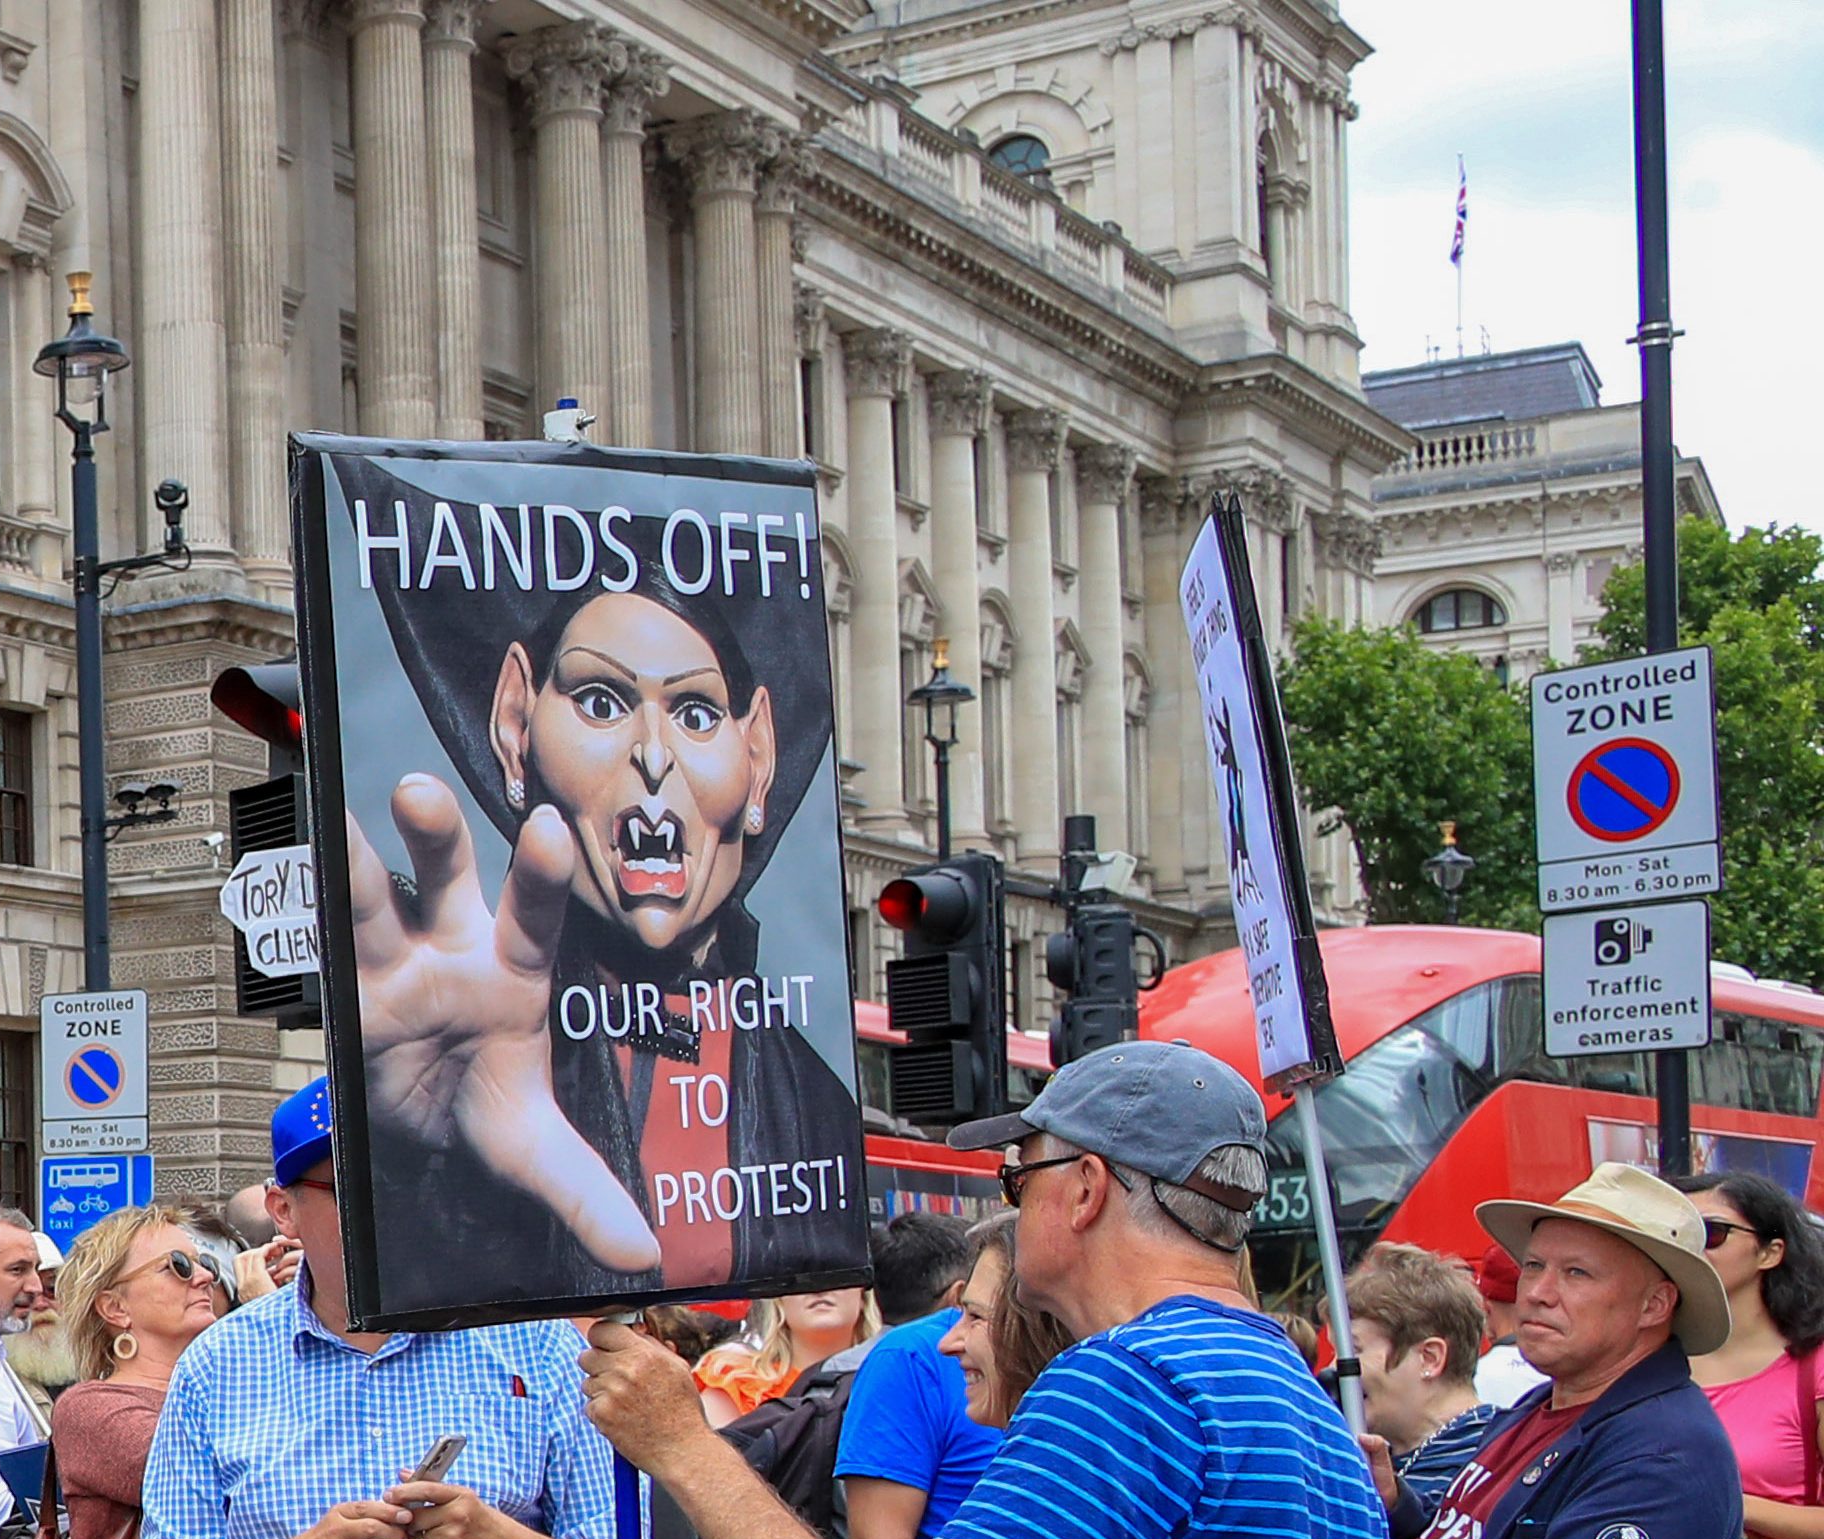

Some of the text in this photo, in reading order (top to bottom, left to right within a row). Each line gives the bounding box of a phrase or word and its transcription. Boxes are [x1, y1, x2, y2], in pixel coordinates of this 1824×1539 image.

[354, 499, 811, 600] HANDS OFF!
[1543, 659, 1697, 704] Controlled
[1566, 694, 1673, 736] ZONE
[1584, 864, 1623, 879] Mon
[1638, 857, 1671, 872] Sat
[232, 859, 290, 921] TORY
[1546, 884, 1590, 904] 8.30
[1593, 885, 1620, 898] am
[1634, 875, 1679, 893] 6.30
[1683, 873, 1712, 889] pm
[256, 923, 320, 966] CLIEN
[1586, 975, 1663, 998] Traffic
[54, 997, 135, 1015] Controlled
[559, 975, 814, 1041] OUR RIGHT
[1553, 996, 1699, 1025] enforcement
[65, 1019, 123, 1039] ZONE
[1578, 1026, 1674, 1047] cameras
[669, 1074, 730, 1129] TO
[70, 1124, 93, 1135] Mon
[101, 1123, 119, 1133] Sat
[74, 1140, 90, 1148] am
[126, 1138, 142, 1149] pm
[654, 1155, 847, 1226] PROTEST!
[1255, 1176, 1310, 1222] 453
[49, 1217, 74, 1230] taxi
